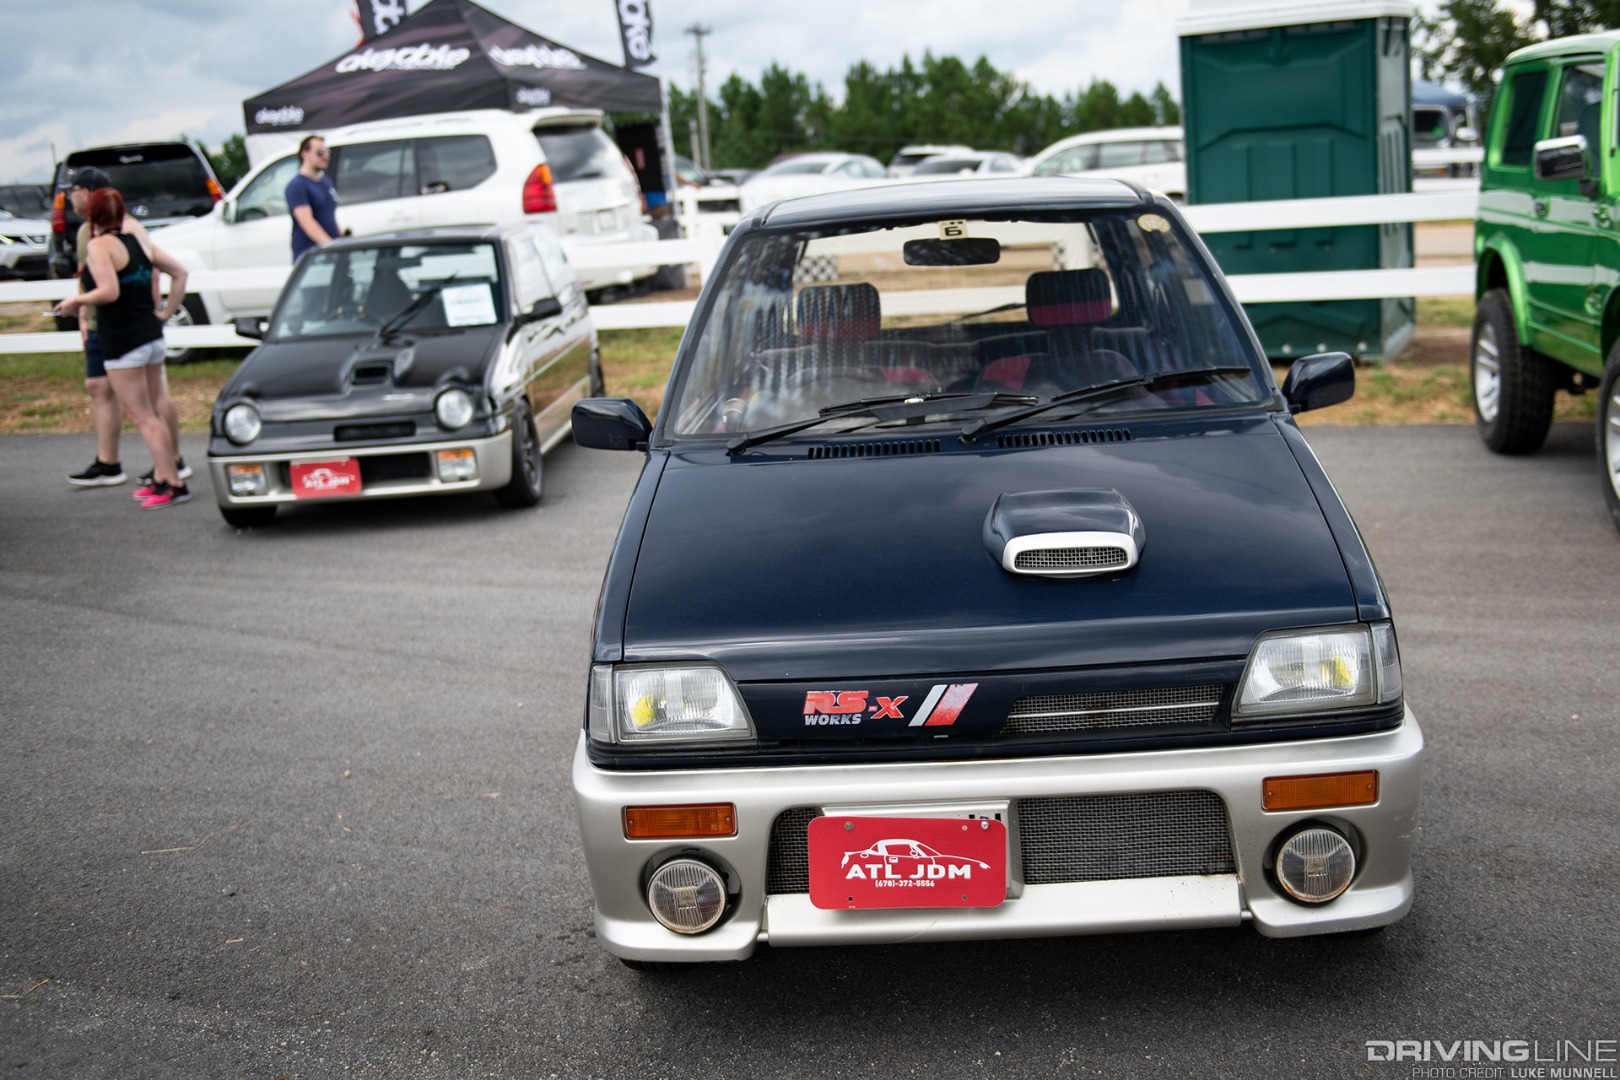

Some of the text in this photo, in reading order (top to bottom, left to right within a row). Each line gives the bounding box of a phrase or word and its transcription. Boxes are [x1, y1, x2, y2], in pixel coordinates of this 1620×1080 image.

[804, 714, 862, 726] WORKS
[845, 864, 971, 879] ATL JDM
